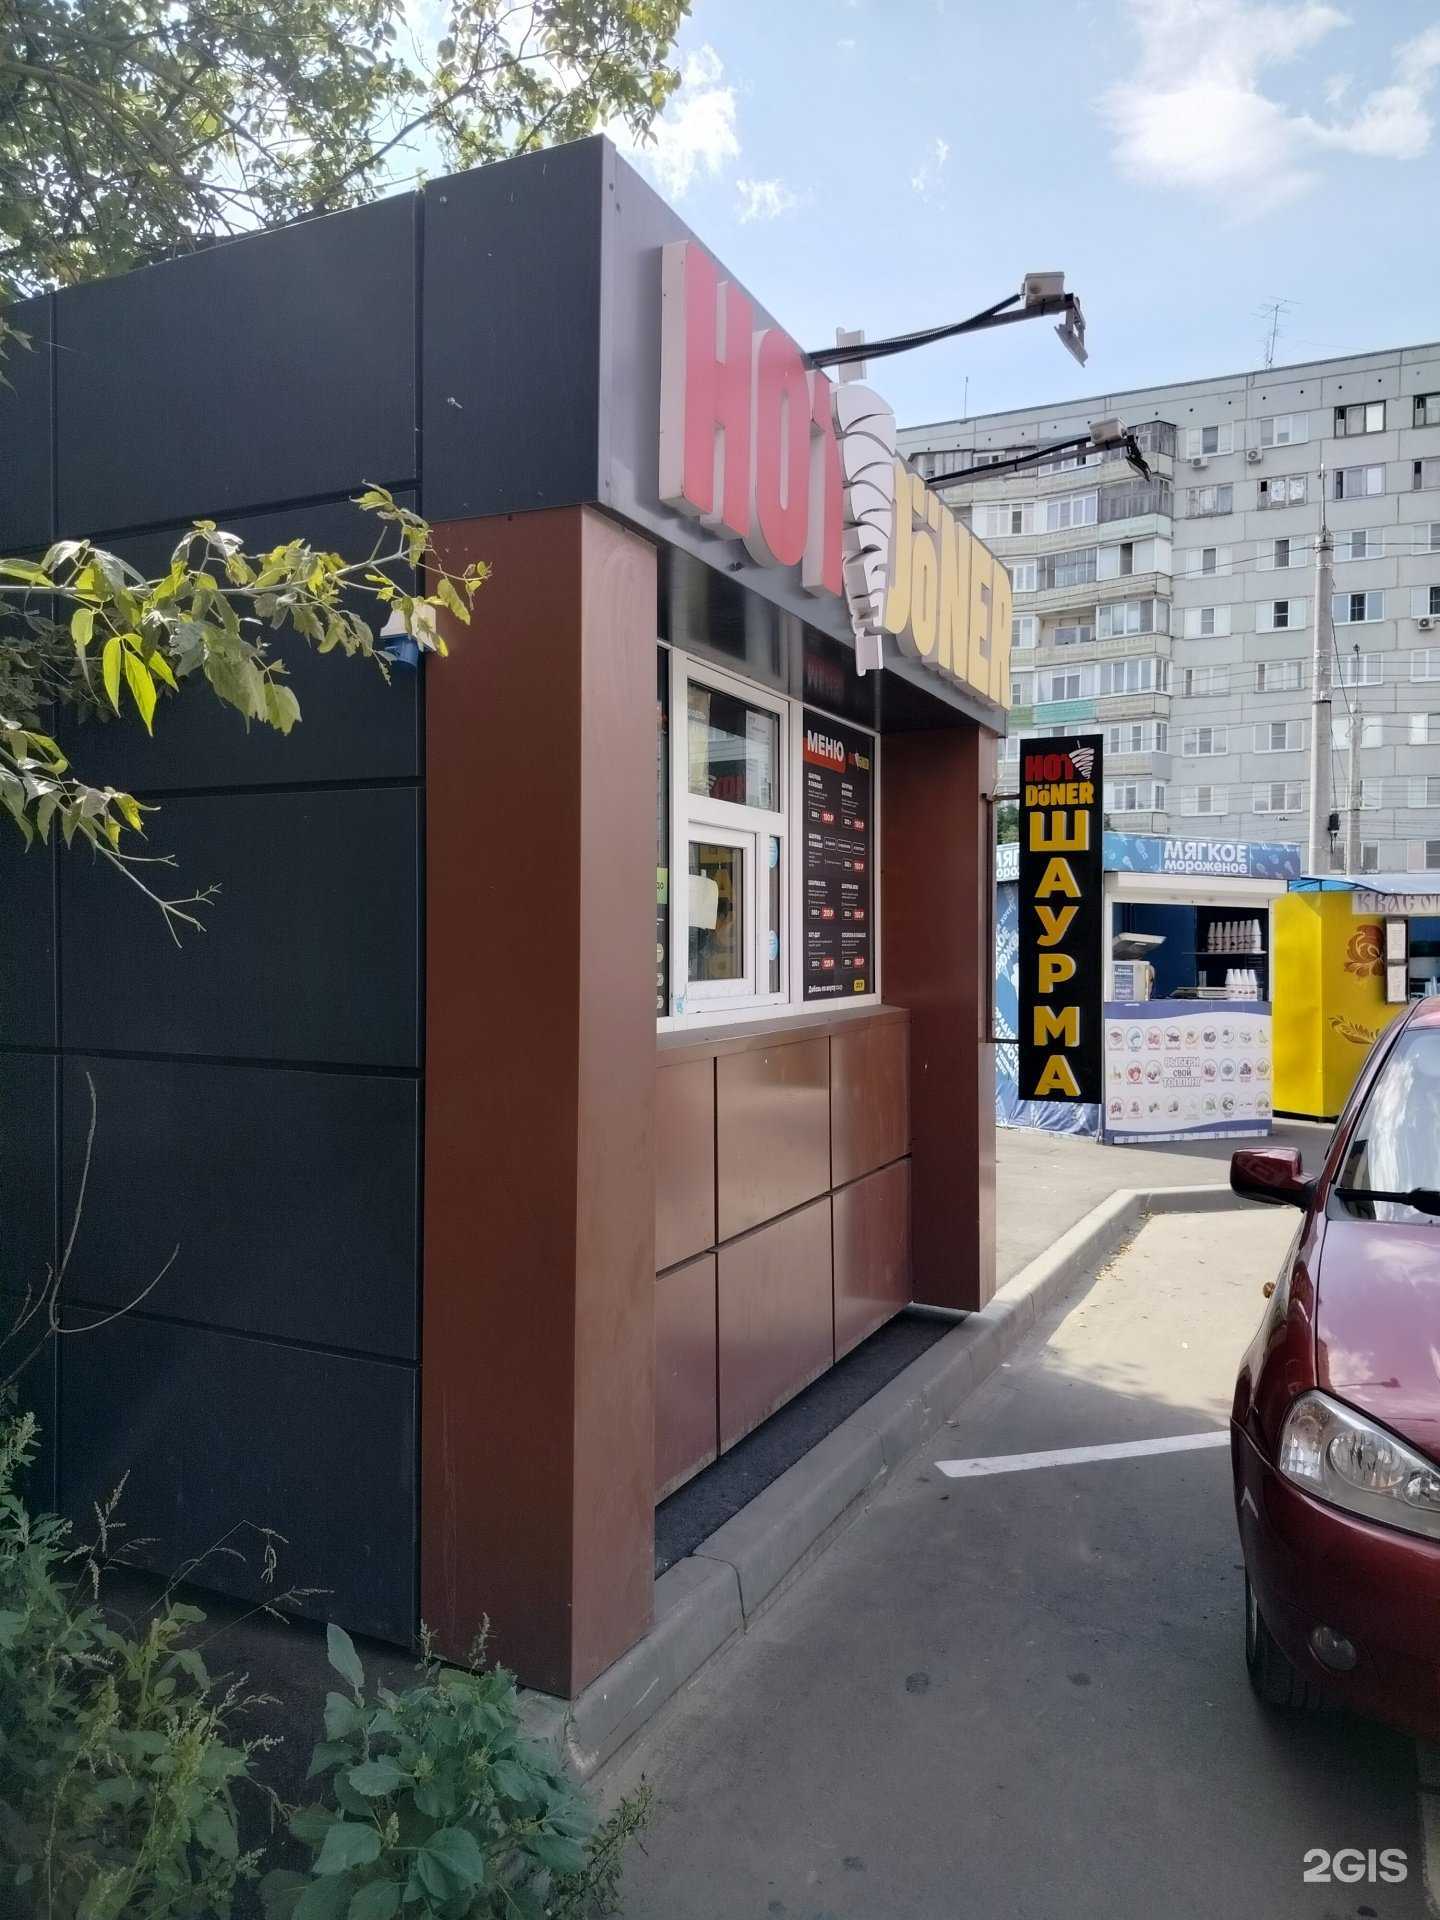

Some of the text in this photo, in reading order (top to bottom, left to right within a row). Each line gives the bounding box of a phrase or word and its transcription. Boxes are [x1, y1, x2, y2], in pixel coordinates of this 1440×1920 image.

[807, 730, 845, 762] МЕНЮ
[1025, 753, 1074, 782] HOT
[1163, 841, 1248, 863] МЯГКОЕ
[1164, 860, 1248, 873] мороженое
[1029, 810, 1090, 1097] ШАУРМА
[1173, 1068, 1192, 1077] СВОЙ
